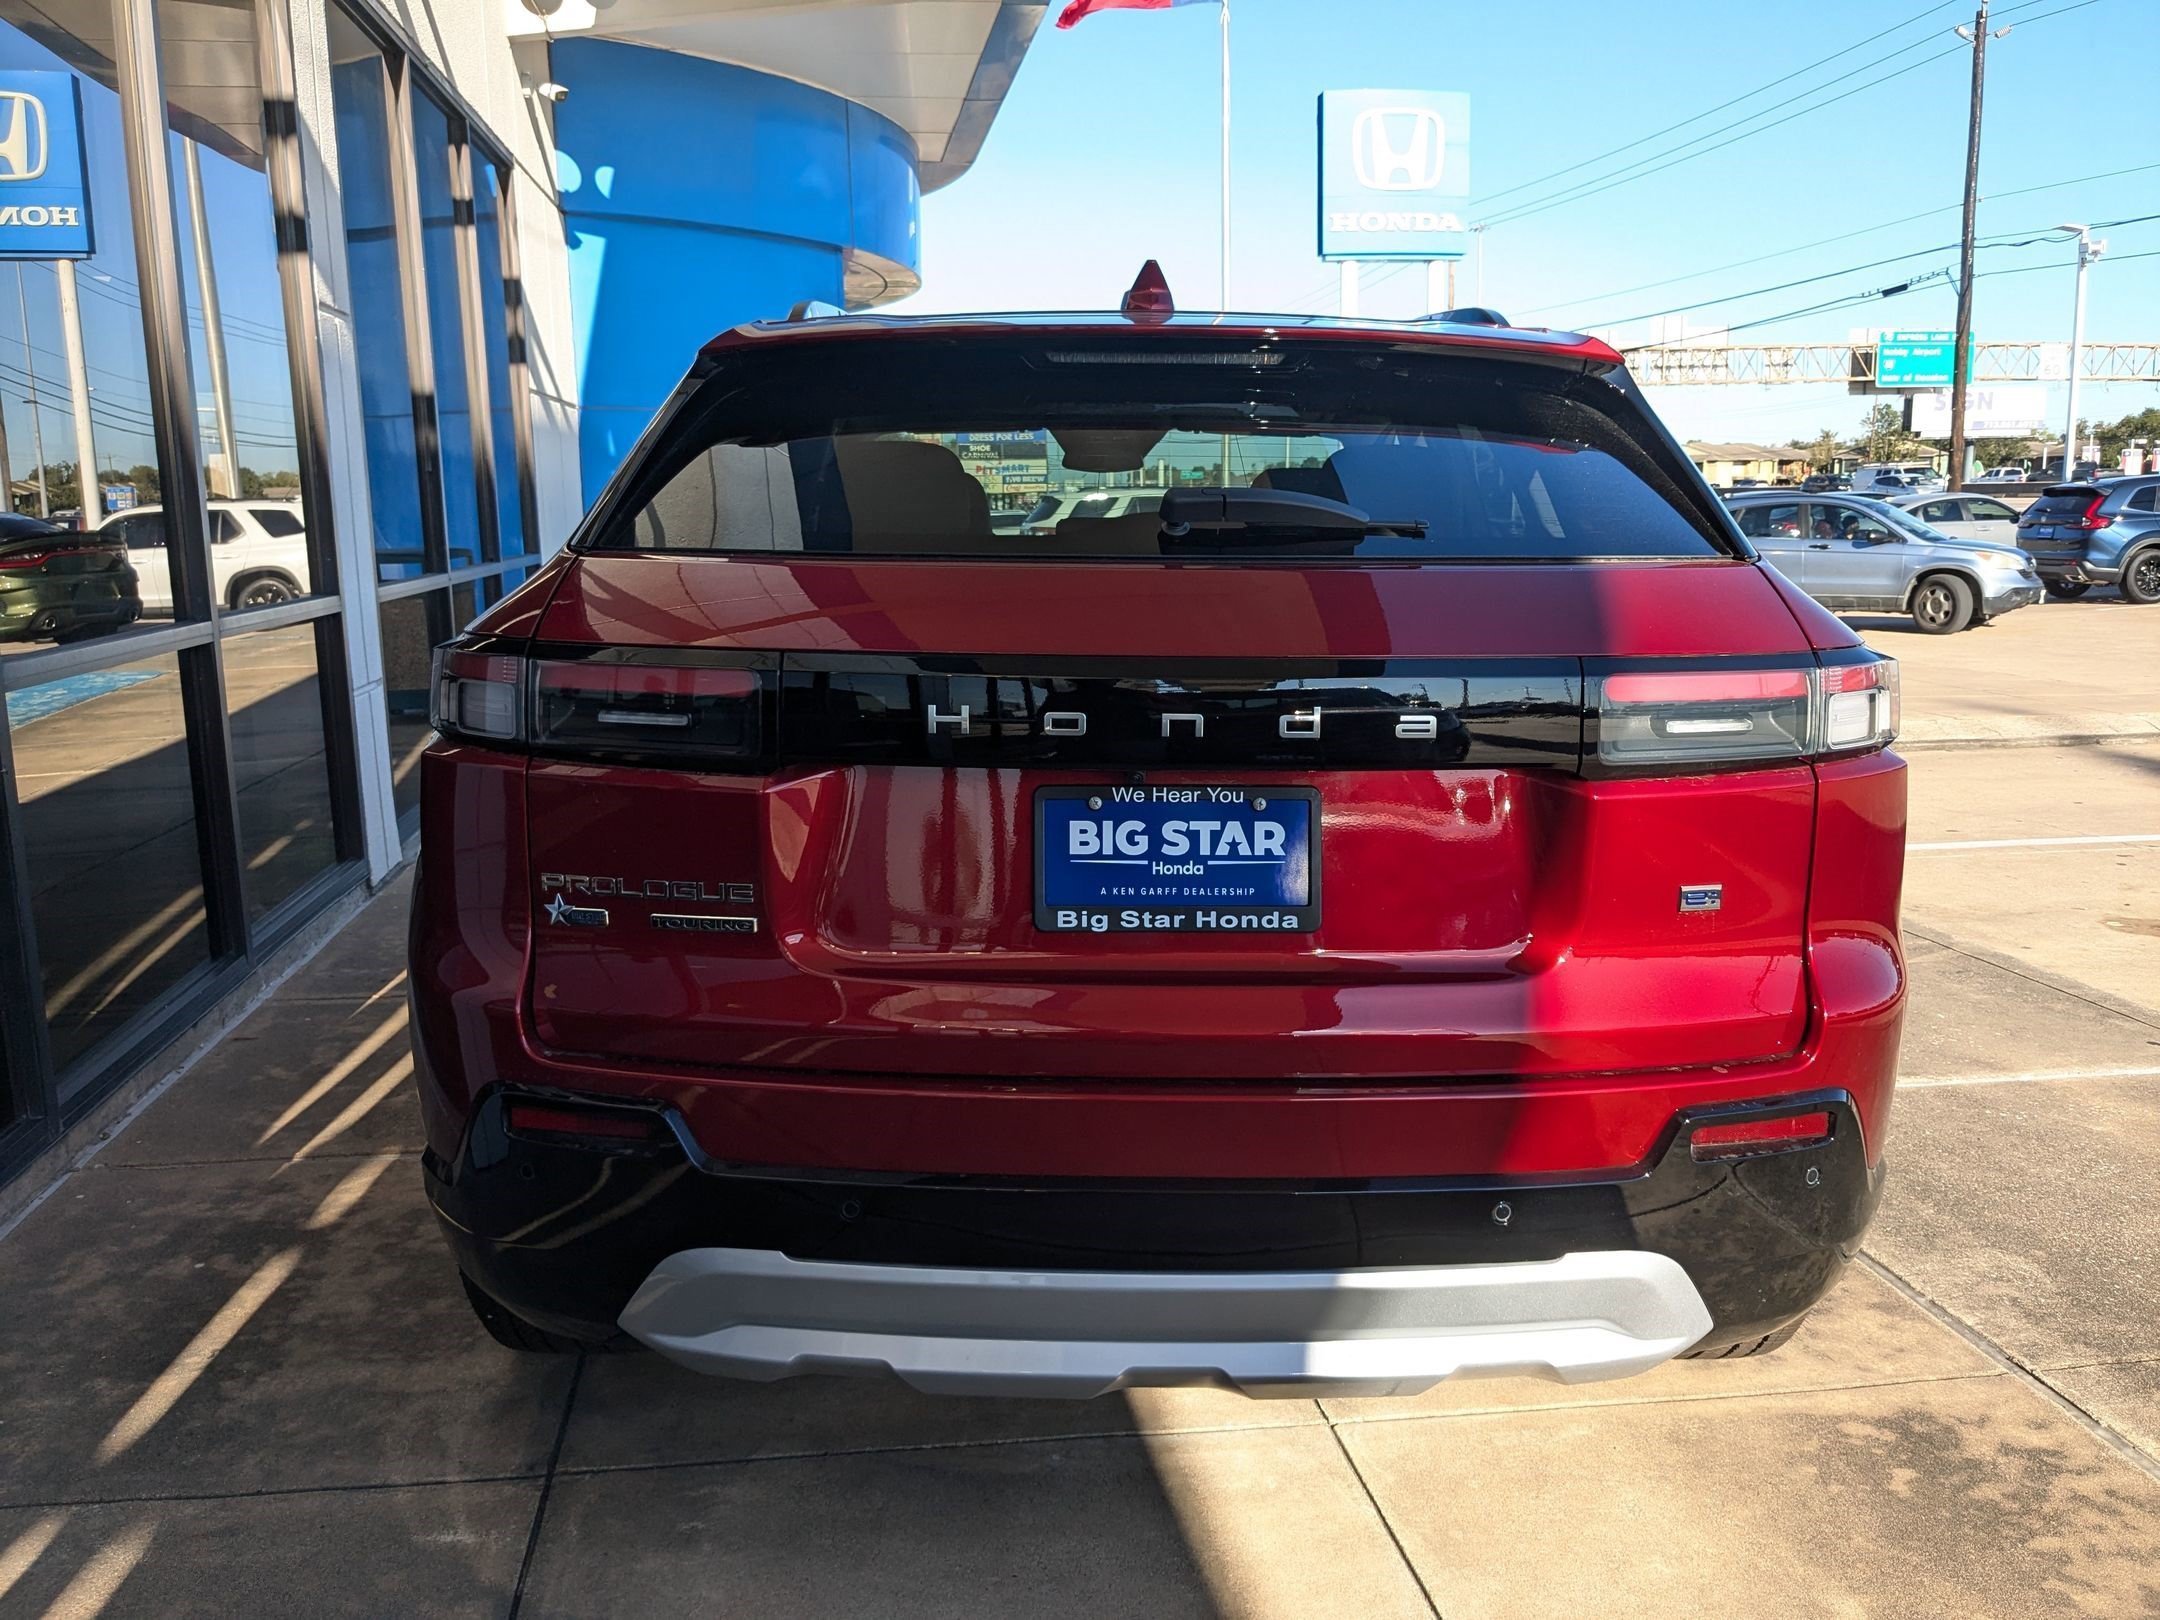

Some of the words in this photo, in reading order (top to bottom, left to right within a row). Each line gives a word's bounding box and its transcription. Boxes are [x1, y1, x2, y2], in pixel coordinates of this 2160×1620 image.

[1329, 212, 1465, 233] HONDA
[1934, 391, 1994, 412] SGN
[996, 433, 1012, 441] FOR
[1014, 431, 1034, 440] LESS
[969, 444, 991, 452] SHOE
[1112, 787, 1145, 803] We
[1152, 787, 1201, 803] Hear
[1207, 787, 1244, 803] You
[1069, 820, 1149, 855] BIG
[1161, 820, 1286, 856] STAR
[1152, 860, 1204, 875] Honda
[541, 872, 754, 903] PROLOGUE
[1101, 887, 1107, 896] A
[1113, 887, 1135, 896] KEN
[1140, 887, 1178, 896] GARFF
[1183, 887, 1256, 896] DEALERSHIP
[653, 916, 752, 932] TOURING
[1057, 910, 1108, 932] Big
[1120, 910, 1185, 929] Star
[1196, 910, 1299, 929] Honda
